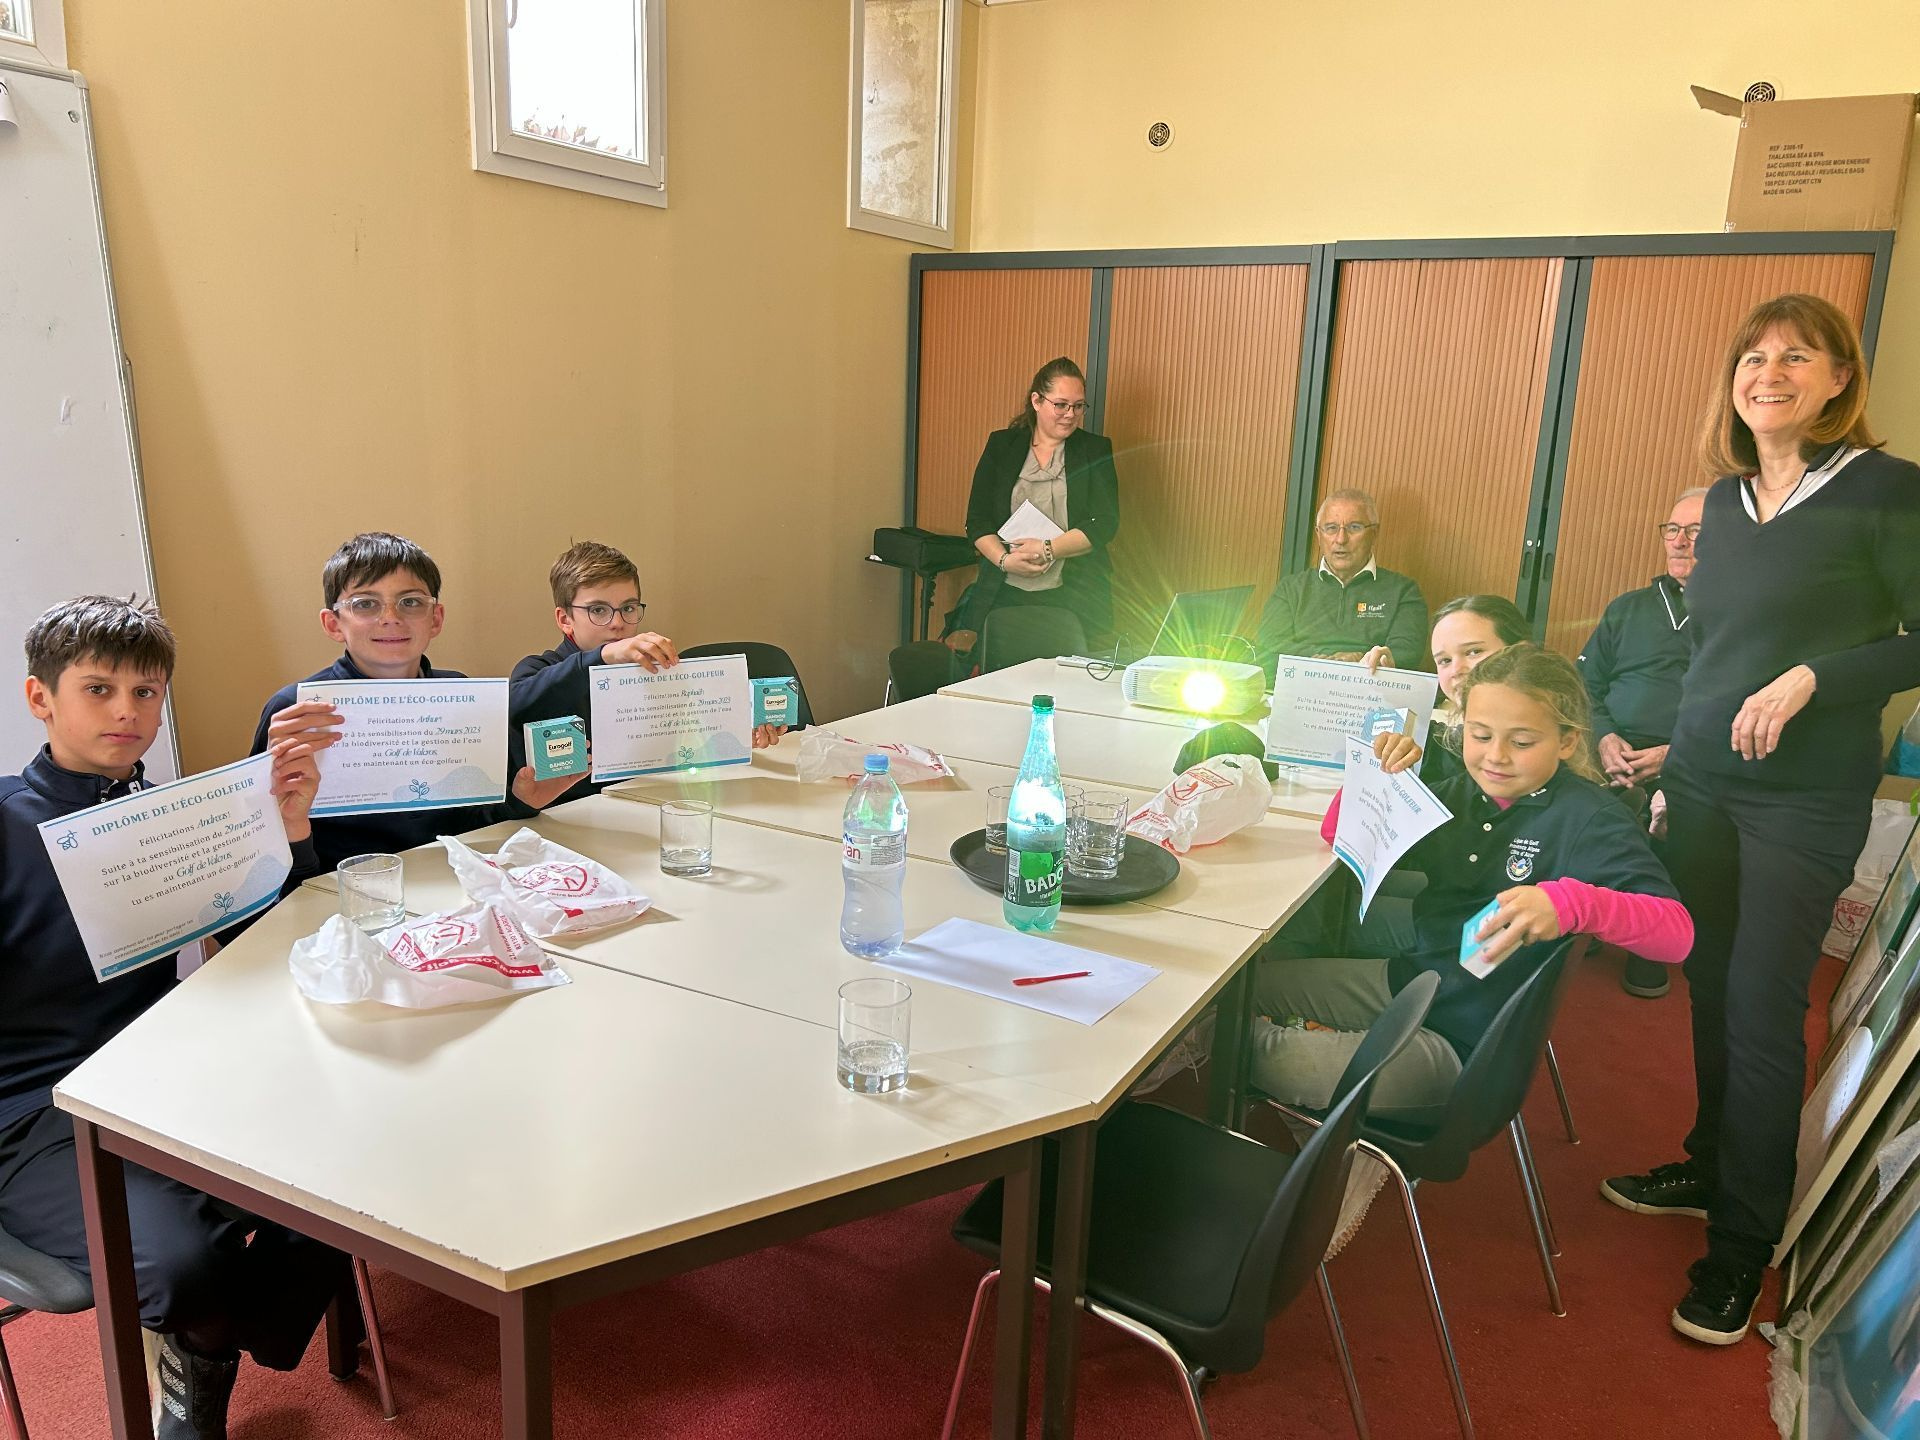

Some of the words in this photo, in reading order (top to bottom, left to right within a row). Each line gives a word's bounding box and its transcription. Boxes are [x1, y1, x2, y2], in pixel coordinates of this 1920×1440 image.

[1768, 152, 1797, 160] THALASSA
[332, 696, 380, 705] DIPLÔME
[382, 696, 396, 704] DE
[399, 694, 476, 704] L'ÉCO-GOLFEUR
[367, 717, 415, 725] Félicitations
[350, 730, 355, 738] à
[368, 729, 422, 738] sensibilisation
[351, 739, 399, 747] biodiversité
[420, 738, 450, 747] gestion
[548, 741, 572, 750] Eurogolf
[91, 811, 150, 836] DIPLÔME
[152, 805, 169, 817] DE
[171, 777, 254, 811] L'ÉCO-GOLFEUR
[139, 823, 195, 847] Félicitations
[101, 863, 127, 876] Suite
[129, 858, 135, 867] à
[149, 834, 211, 861] sensibilisation
[212, 830, 223, 839] du
[224, 824, 235, 835] 29
[103, 878, 120, 888] sur
[122, 874, 132, 882] la
[133, 853, 190, 878] biodiversité
[191, 850, 201, 859] et
[202, 845, 211, 855] la
[212, 835, 241, 853] gestion
[242, 829, 251, 839] de
[131, 898, 142, 906] tu
[144, 893, 154, 902] es
[155, 874, 205, 898] maintenant
[206, 871, 217, 879] un
[218, 852, 256, 874] éco-golfeur
[163, 875, 174, 883] au
[176, 861, 196, 878] Golf
[196, 860, 207, 871] de
